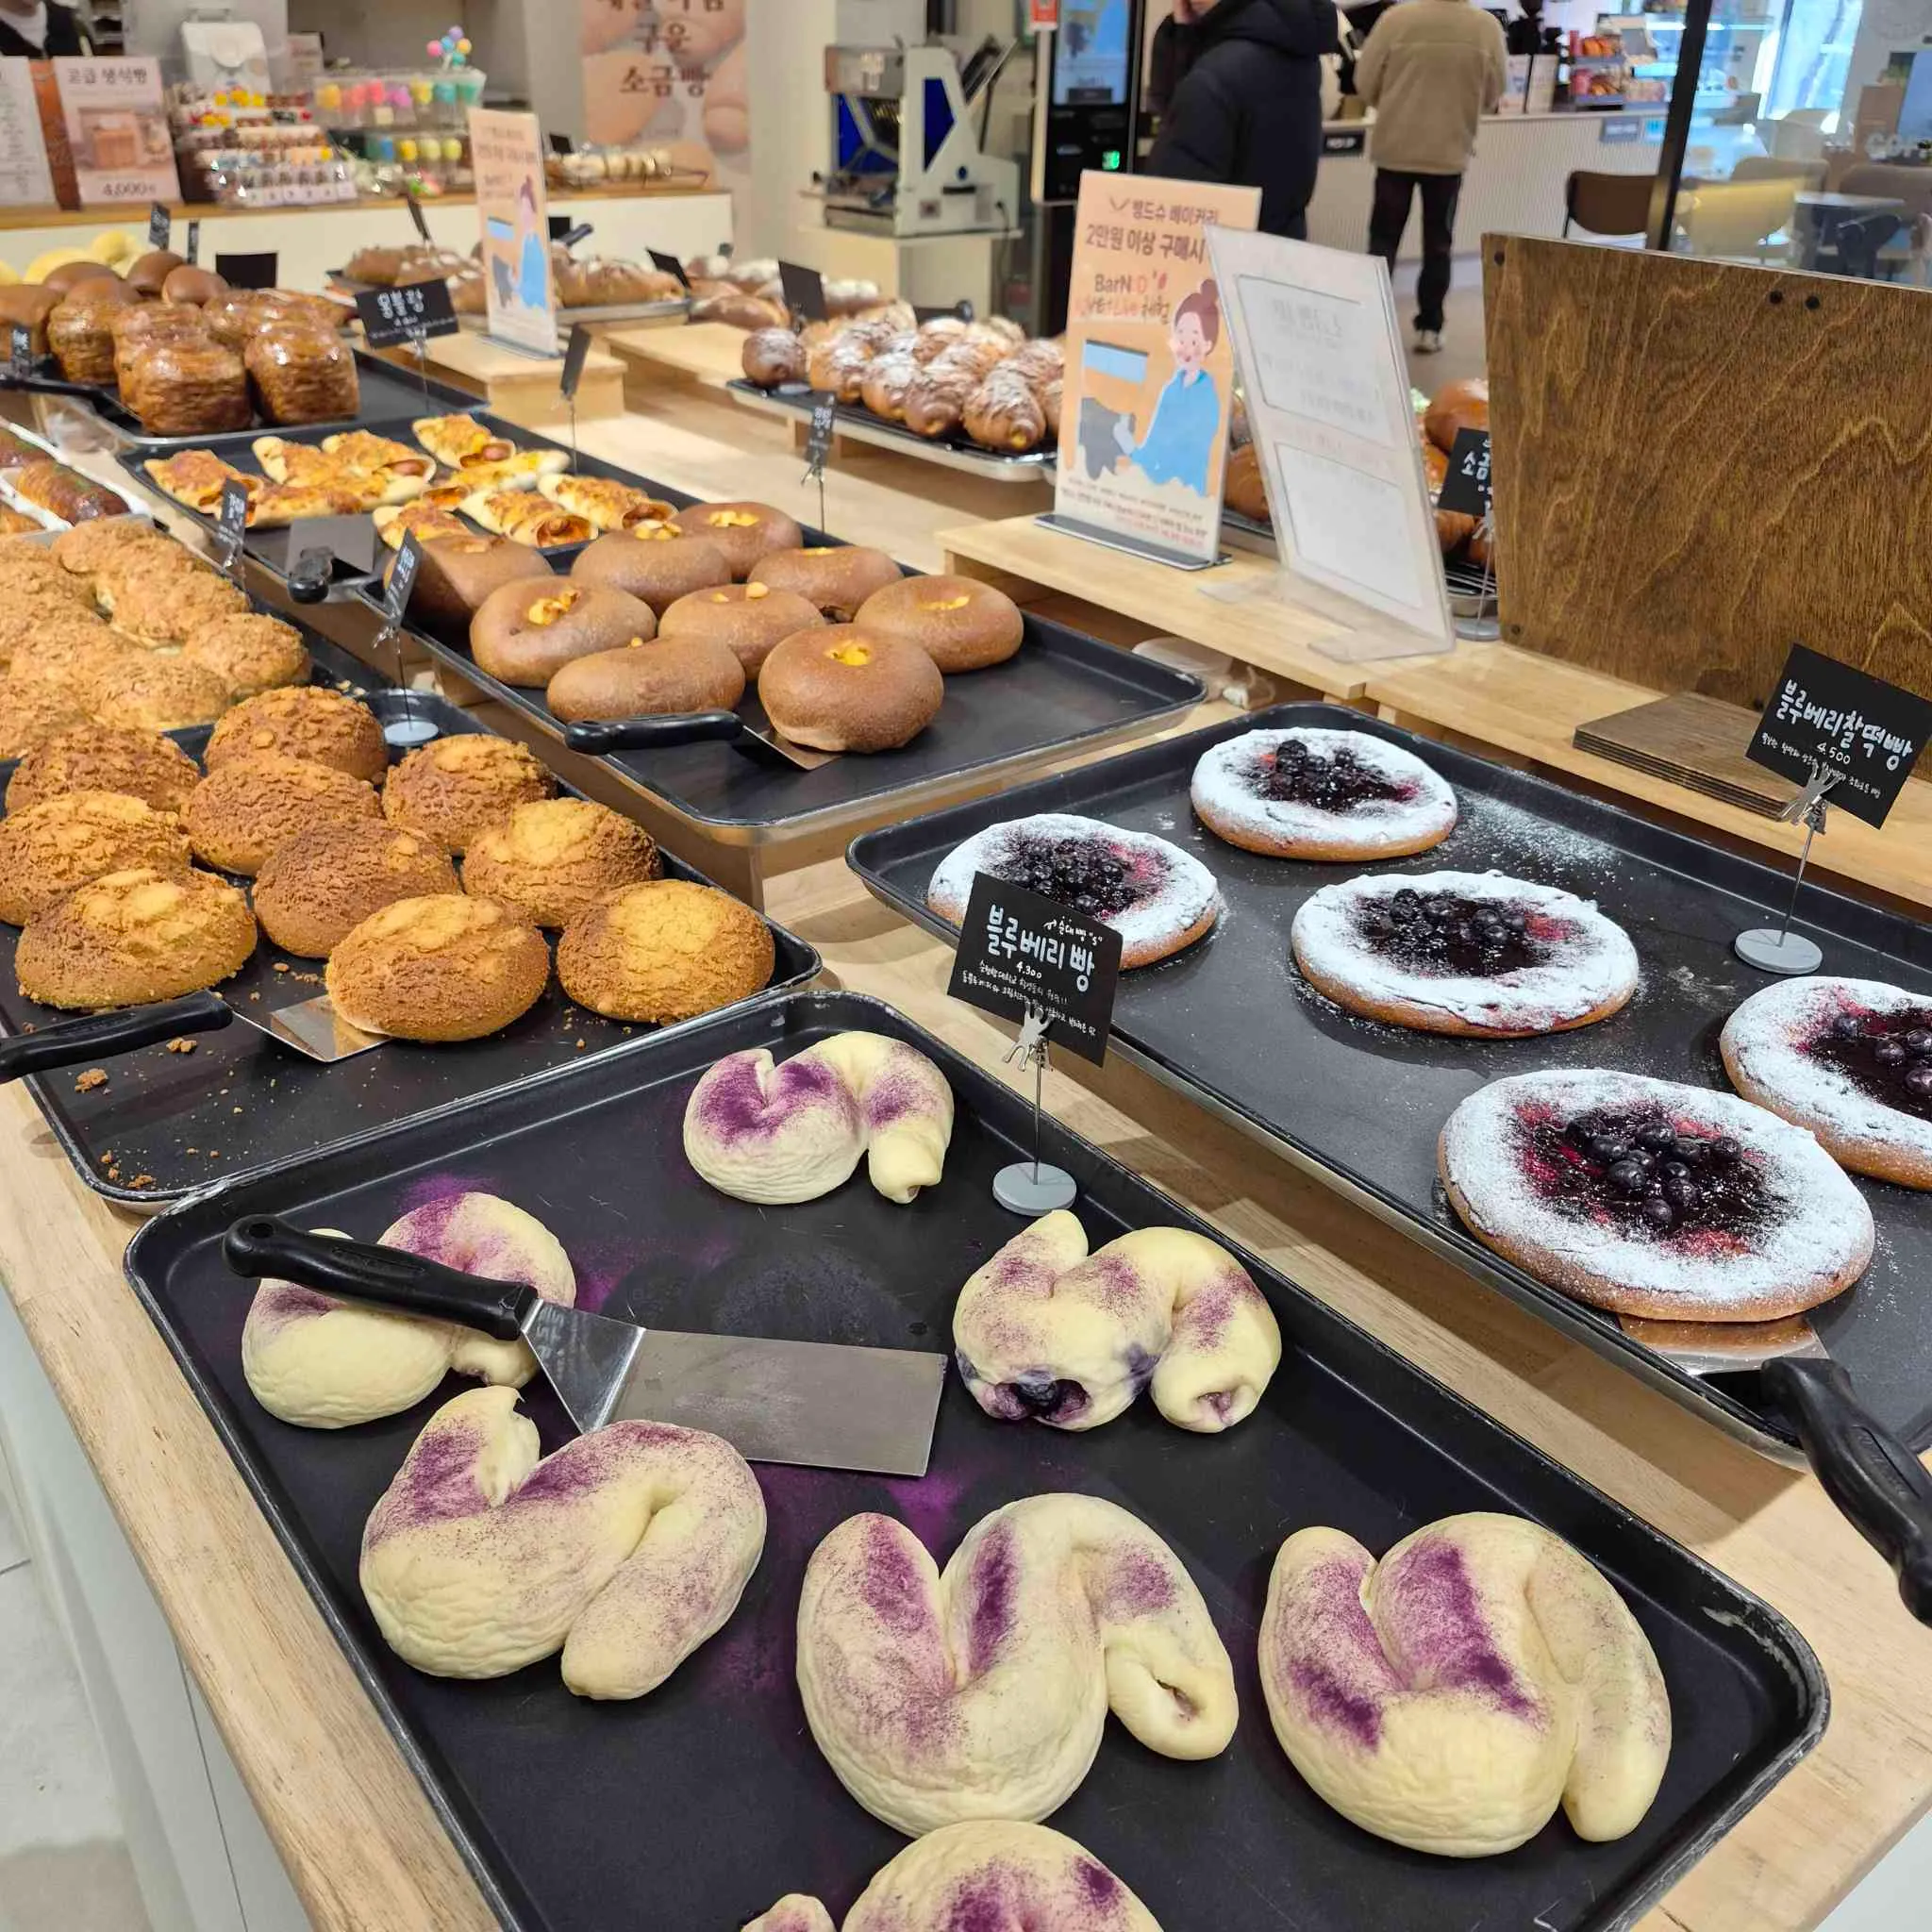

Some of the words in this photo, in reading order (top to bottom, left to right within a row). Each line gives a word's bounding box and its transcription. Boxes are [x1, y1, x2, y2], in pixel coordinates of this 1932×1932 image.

[634, 23, 691, 55] 구운
[619, 65, 712, 97] 소금빵
[1086, 224, 1124, 251] 2만원
[1127, 229, 1156, 257] 이상
[1159, 234, 1206, 264] 구매시
[1775, 679, 1913, 771] 블루베리찰떡빵
[1816, 741, 1851, 765] 4.500
[986, 904, 1066, 970] 블루베리
[1070, 943, 1095, 992] 빵
[1016, 960, 1042, 979] 4.300
